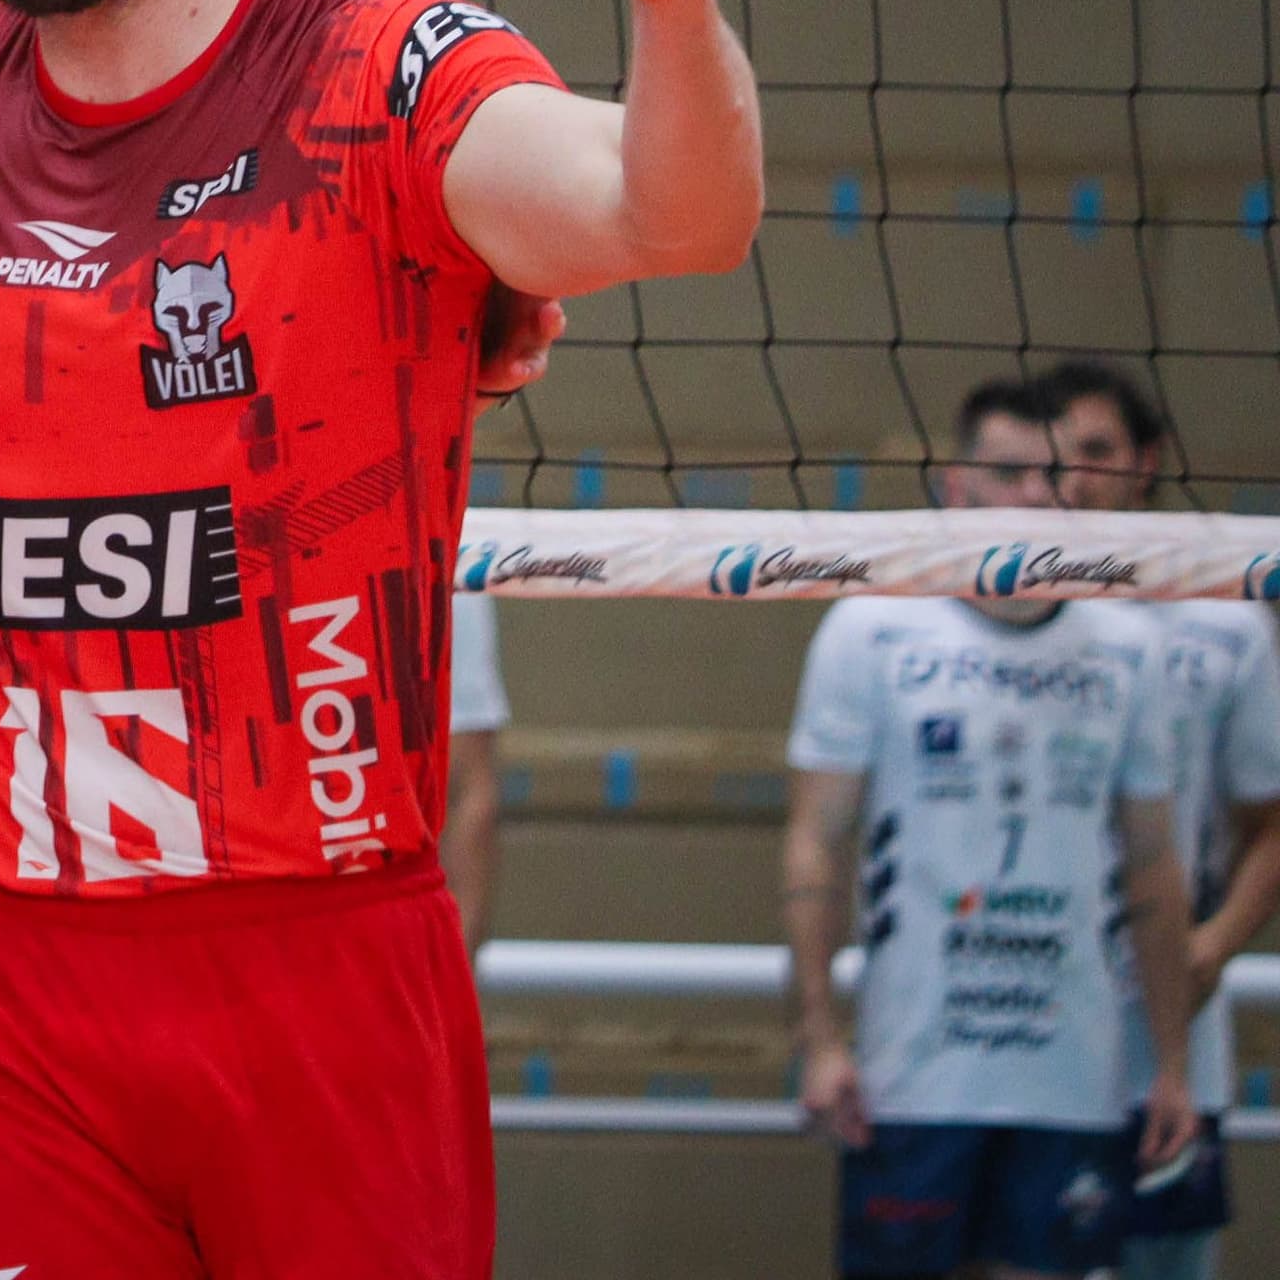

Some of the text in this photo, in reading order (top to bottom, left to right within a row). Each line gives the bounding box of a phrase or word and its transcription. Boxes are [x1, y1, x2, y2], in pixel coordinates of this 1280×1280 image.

[401, 3, 523, 107] SES
[152, 347, 245, 400] VÔLEI
[288, 595, 390, 874] Mobif
